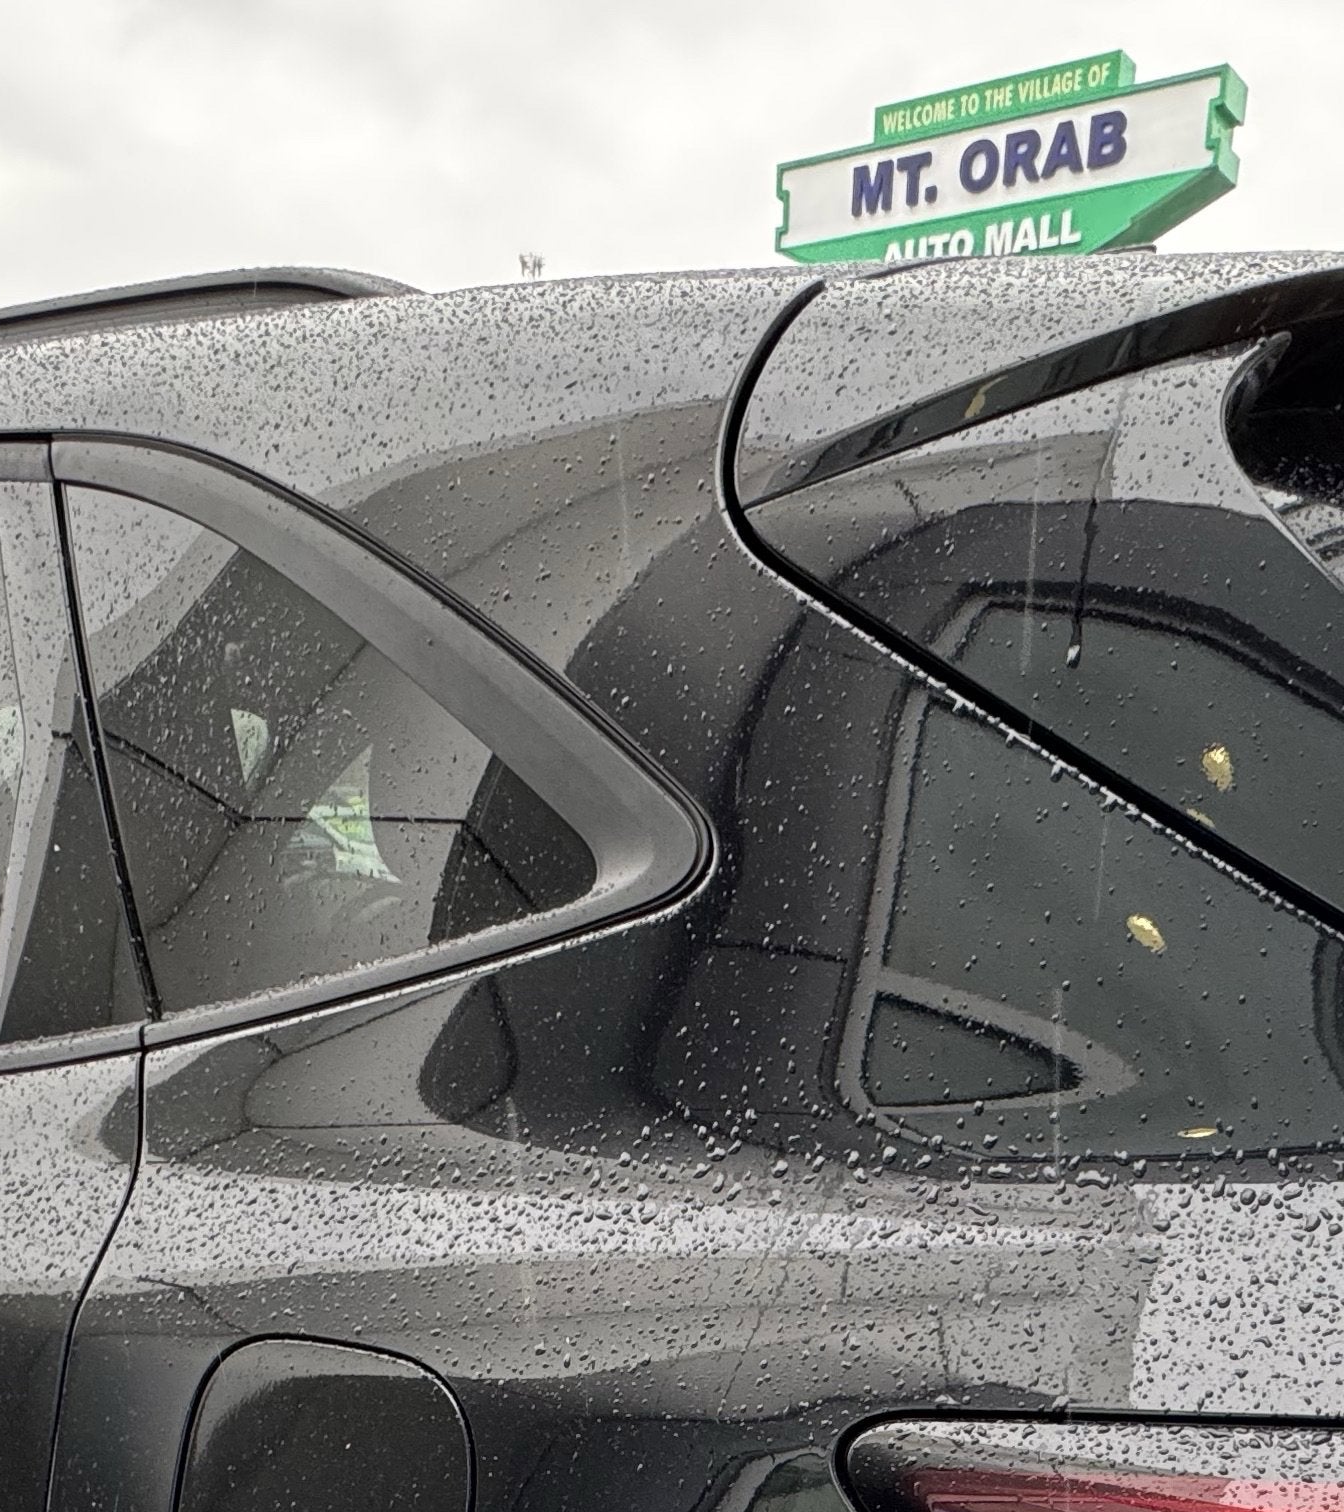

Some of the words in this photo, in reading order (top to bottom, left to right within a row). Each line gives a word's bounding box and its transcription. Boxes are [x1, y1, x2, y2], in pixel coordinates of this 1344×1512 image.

[882, 100, 954, 134] WELCOME
[960, 95, 979, 116] TO
[984, 84, 1013, 112] THE
[1017, 70, 1082, 102] VILLAGE
[1088, 63, 1110, 86] OF
[851, 151, 938, 218] MT.
[959, 110, 1128, 194] ORAB
[884, 230, 974, 262] AUTO
[984, 210, 1081, 256] MALL
